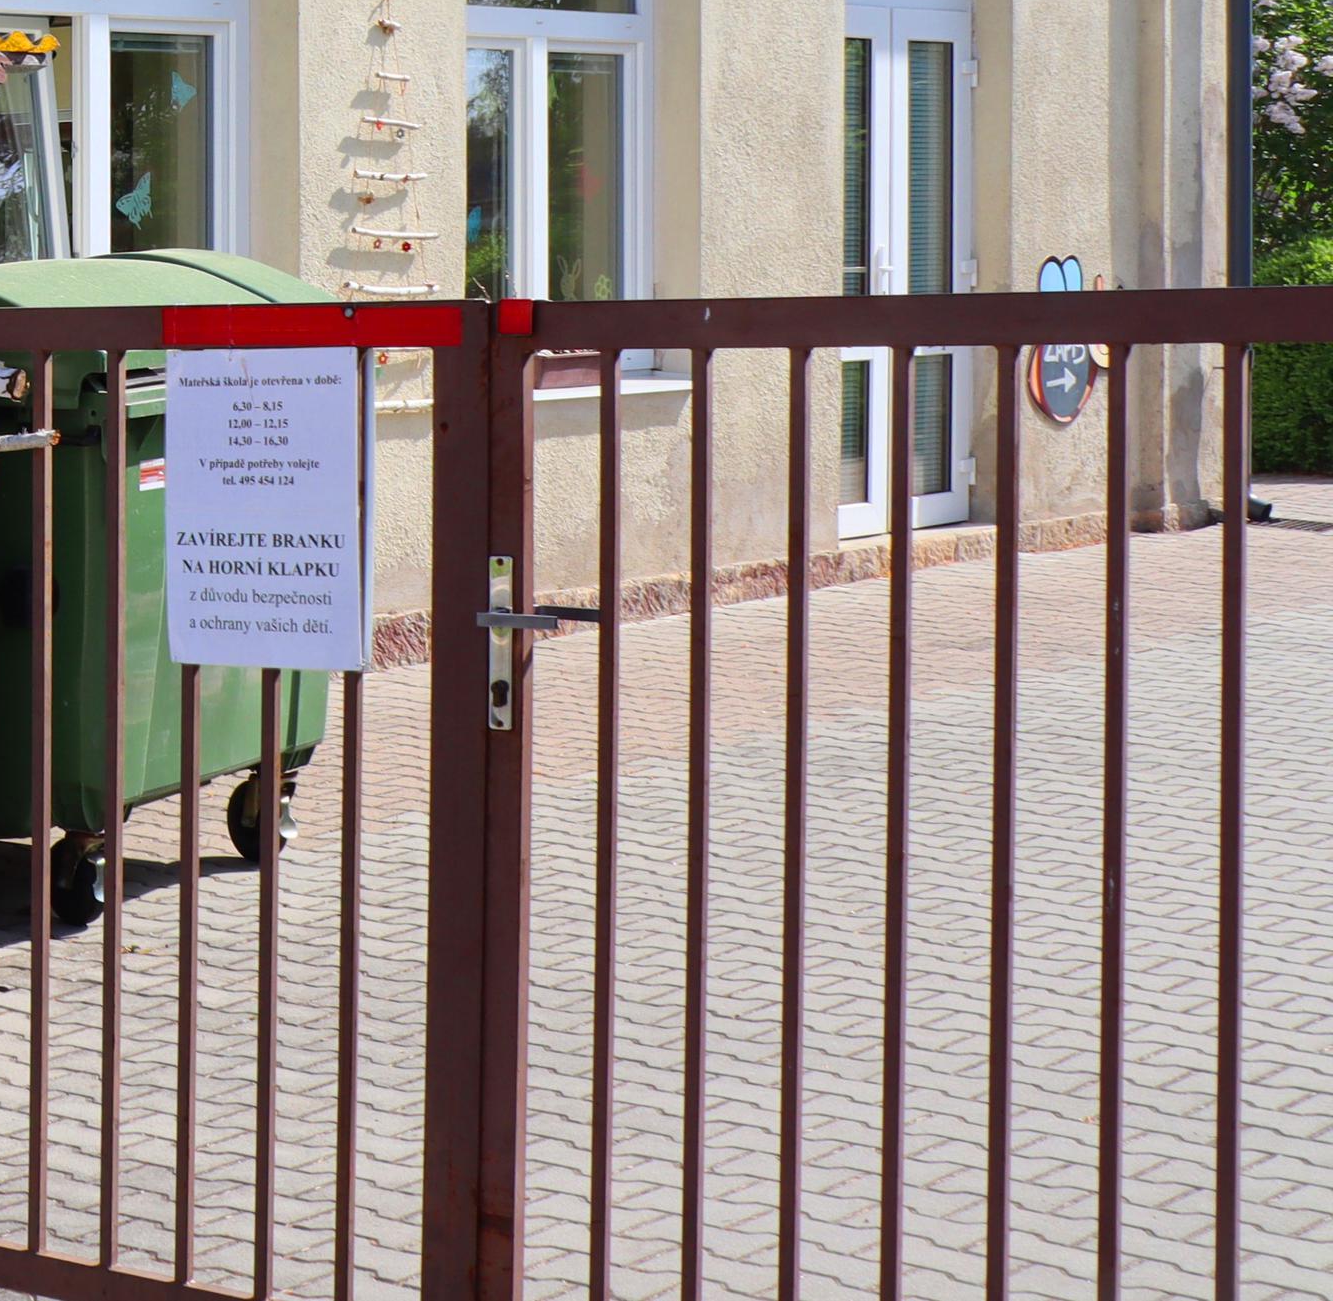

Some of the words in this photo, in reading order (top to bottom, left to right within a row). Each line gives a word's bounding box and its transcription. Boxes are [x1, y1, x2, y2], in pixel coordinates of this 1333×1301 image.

[179, 377, 221, 387] Mateřská
[223, 376, 248, 387] škola
[249, 376, 259, 388] je
[261, 376, 303, 386] otevřena
[314, 375, 342, 385] době:
[232, 401, 252, 412] 6,30
[262, 401, 283, 412] 8,15
[228, 419, 252, 429] 12,00
[263, 419, 289, 429] 12,15
[228, 436, 253, 446] 14,30
[263, 436, 289, 446] 16,30
[198, 458, 207, 467] V
[209, 458, 245, 470] případě
[247, 458, 284, 471] potřeby
[287, 458, 320, 470] volejte
[222, 475, 236, 485] tel.
[239, 476, 255, 485] 495
[258, 476, 275, 485] 454
[278, 476, 295, 485] 124
[176, 528, 267, 548] ZAVÍREJTE
[272, 532, 346, 549] BRANKU
[182, 559, 204, 574] NA
[209, 557, 263, 575] HORNÍ
[268, 561, 340, 577] KLAPKU
[189, 591, 196, 601] z
[200, 587, 248, 603] důvodu
[252, 588, 333, 607] bezpečnosti
[189, 618, 196, 629] a
[199, 616, 251, 634] ochrany
[255, 618, 298, 633] vašich
